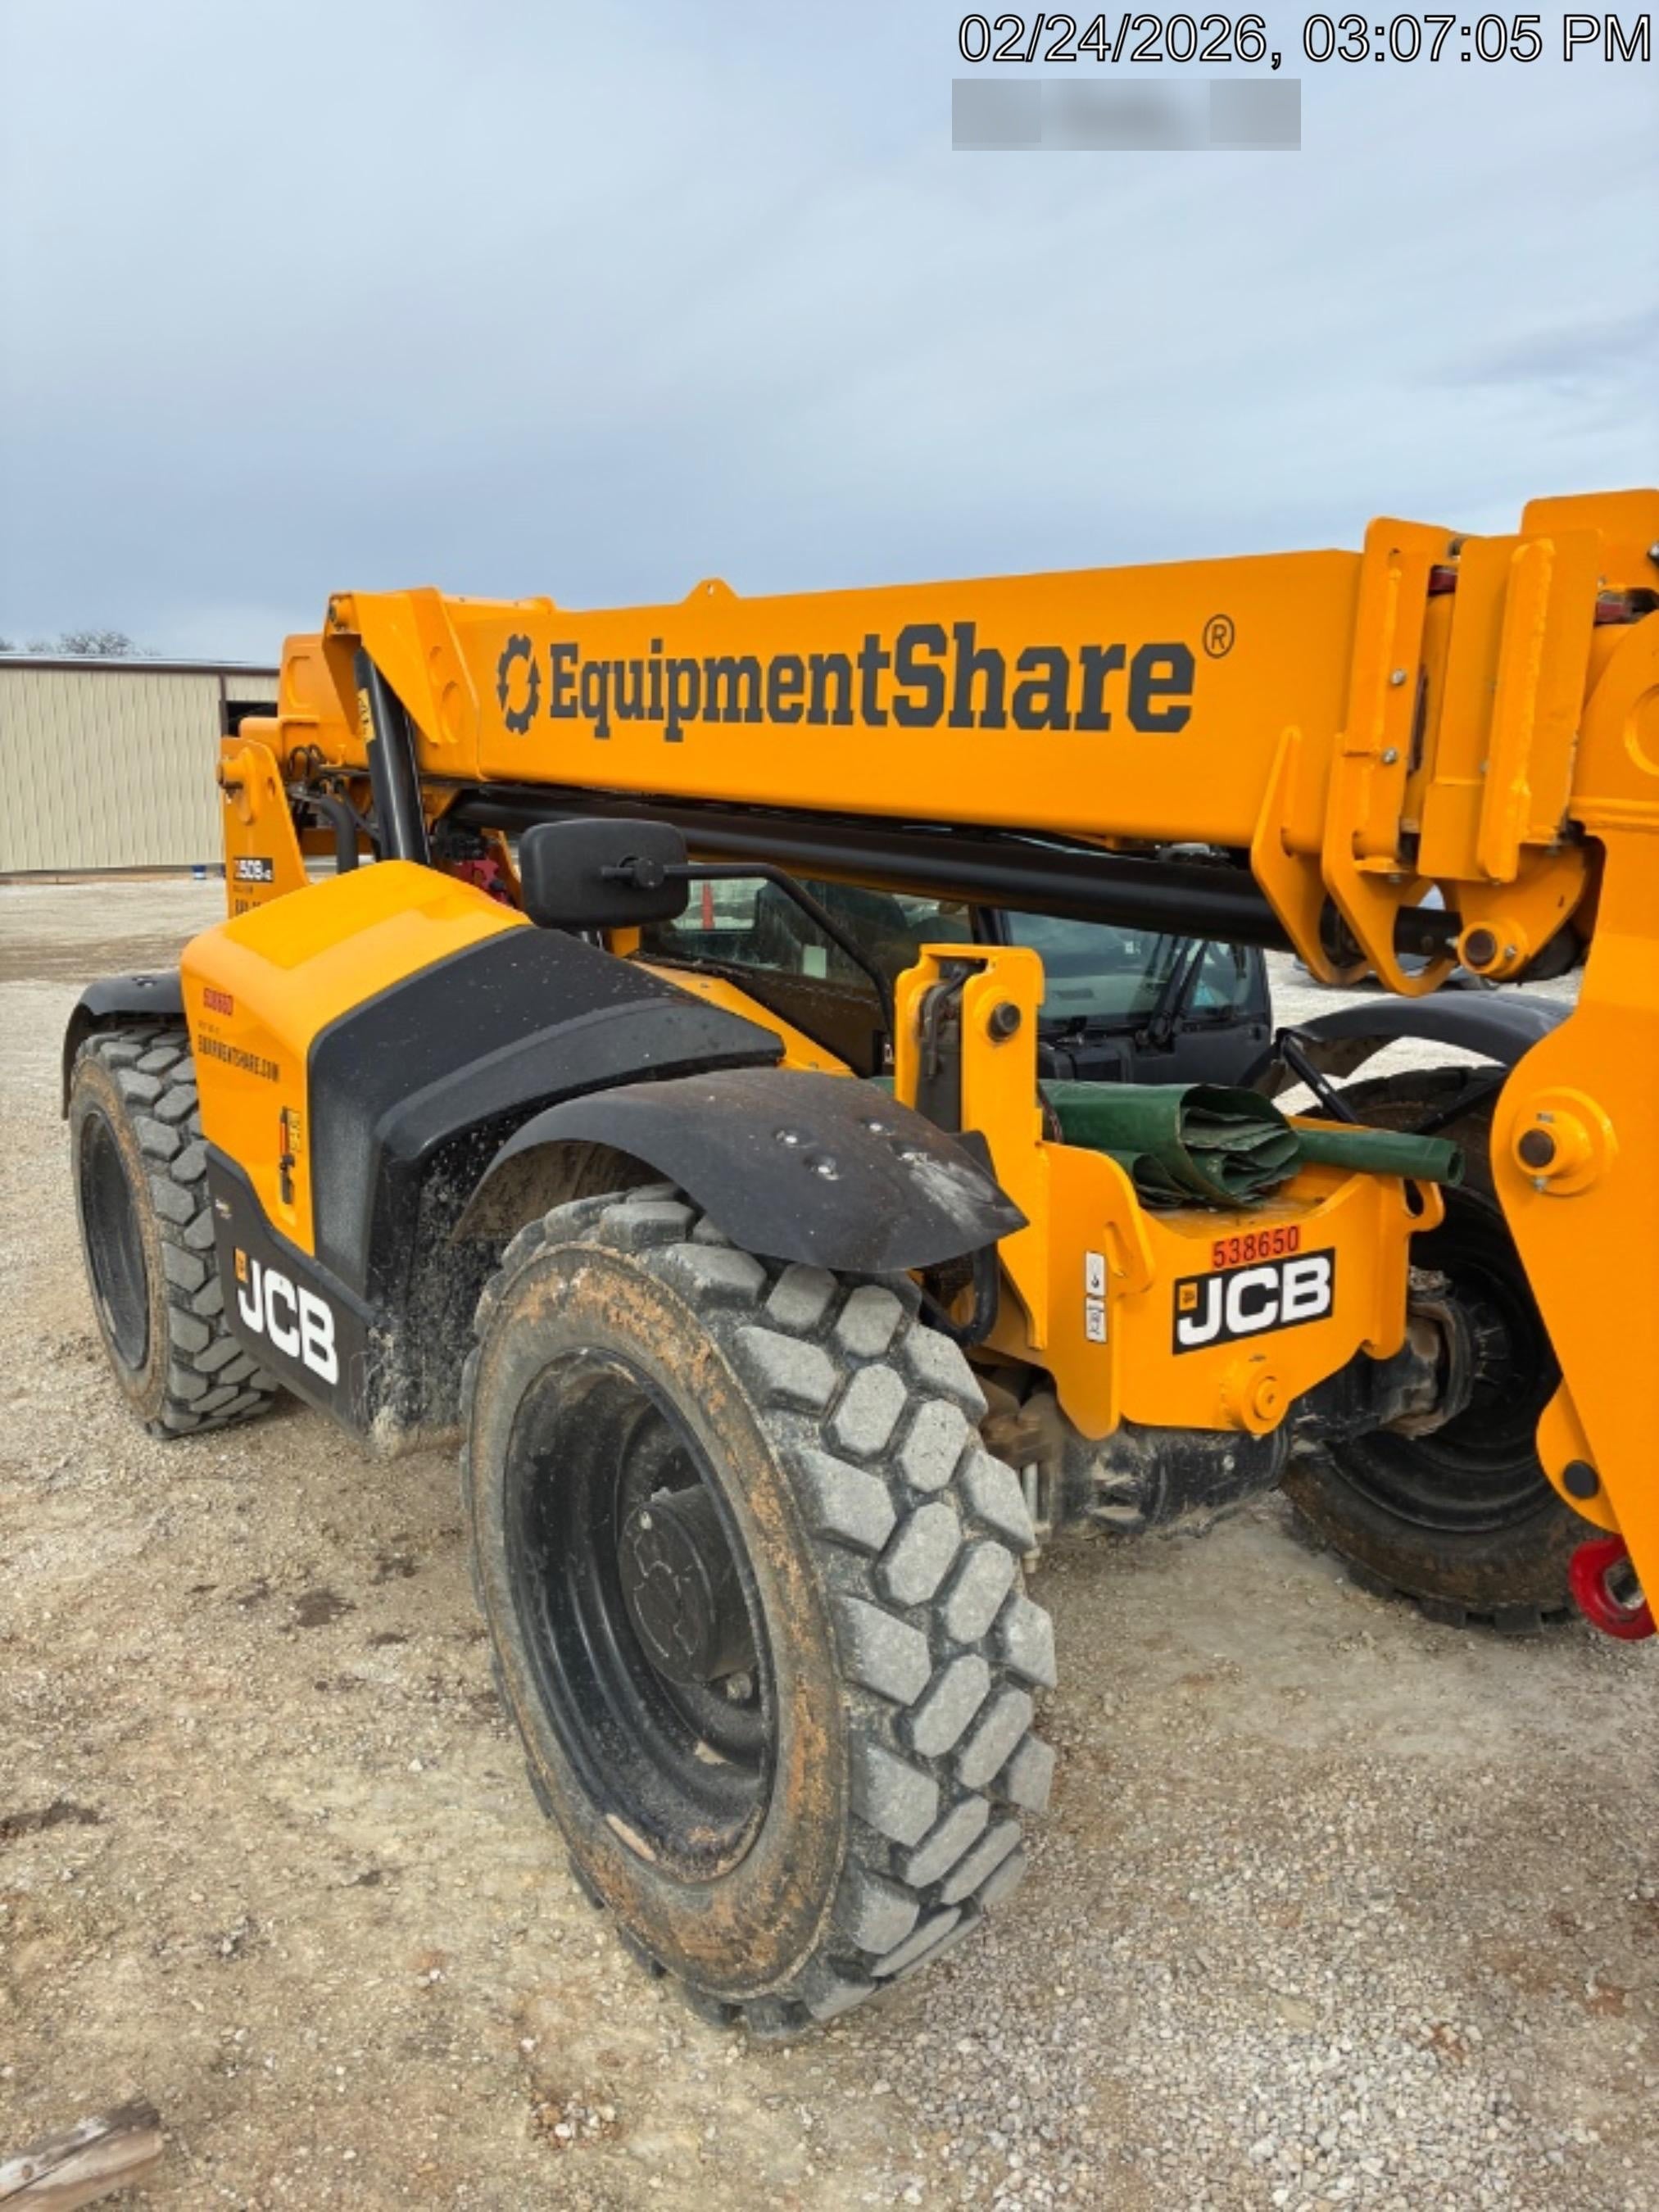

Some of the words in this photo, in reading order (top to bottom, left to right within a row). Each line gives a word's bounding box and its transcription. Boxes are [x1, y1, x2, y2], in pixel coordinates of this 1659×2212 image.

[549, 621, 1195, 741] EquipmentShare
[1212, 1226, 1300, 1269] 538650
[237, 1258, 339, 1385] JCB
[1176, 1256, 1331, 1346] JCB
